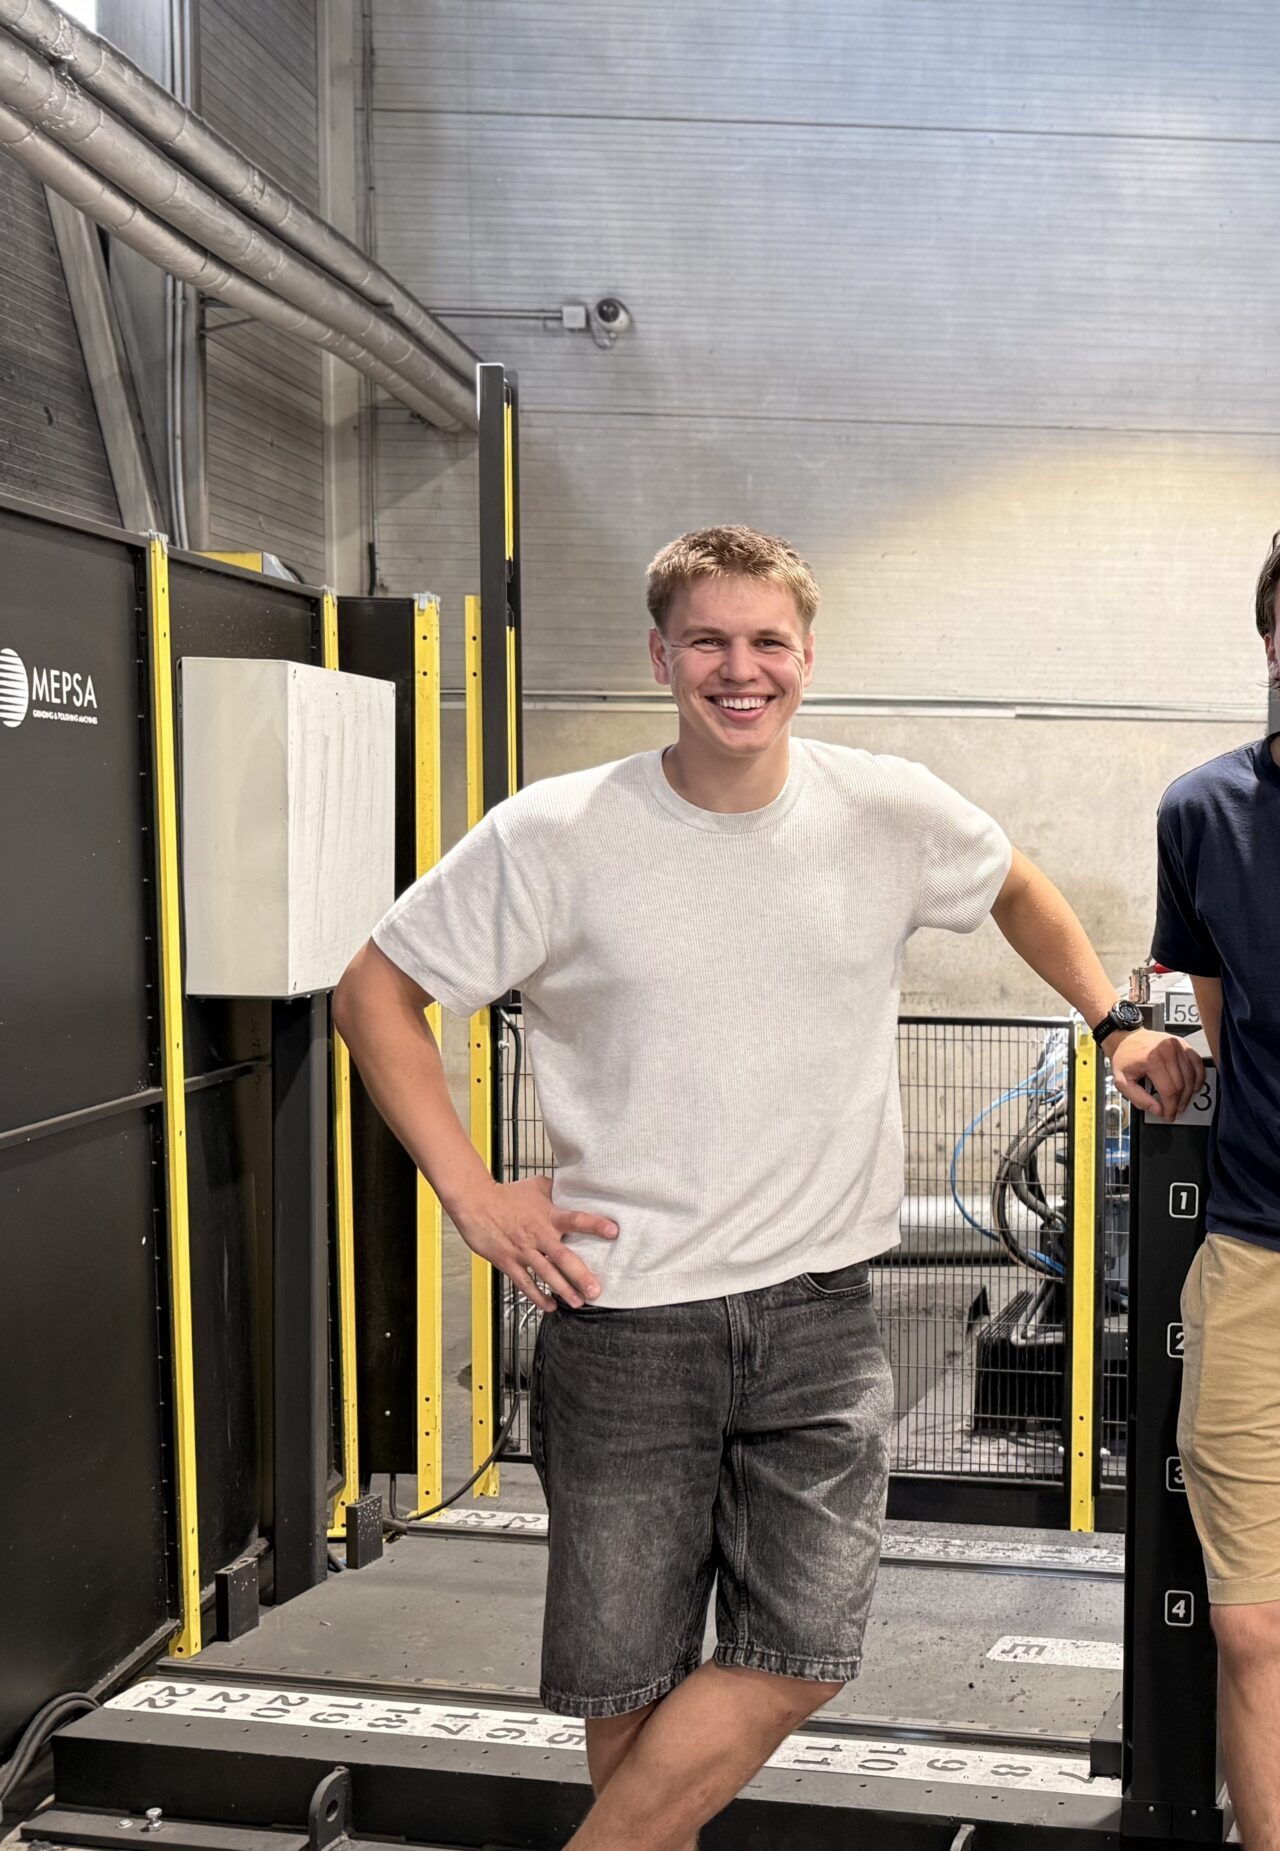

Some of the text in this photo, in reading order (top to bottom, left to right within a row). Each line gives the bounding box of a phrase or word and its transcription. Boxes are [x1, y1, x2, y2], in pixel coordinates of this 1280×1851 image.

[32, 666, 98, 709] MEPSA
[1171, 1599, 1186, 1618] 4
[1000, 1643, 1048, 1656] E
[133, 1685, 196, 1709] 22
[191, 1691, 250, 1713] 21
[250, 1694, 309, 1719] 20
